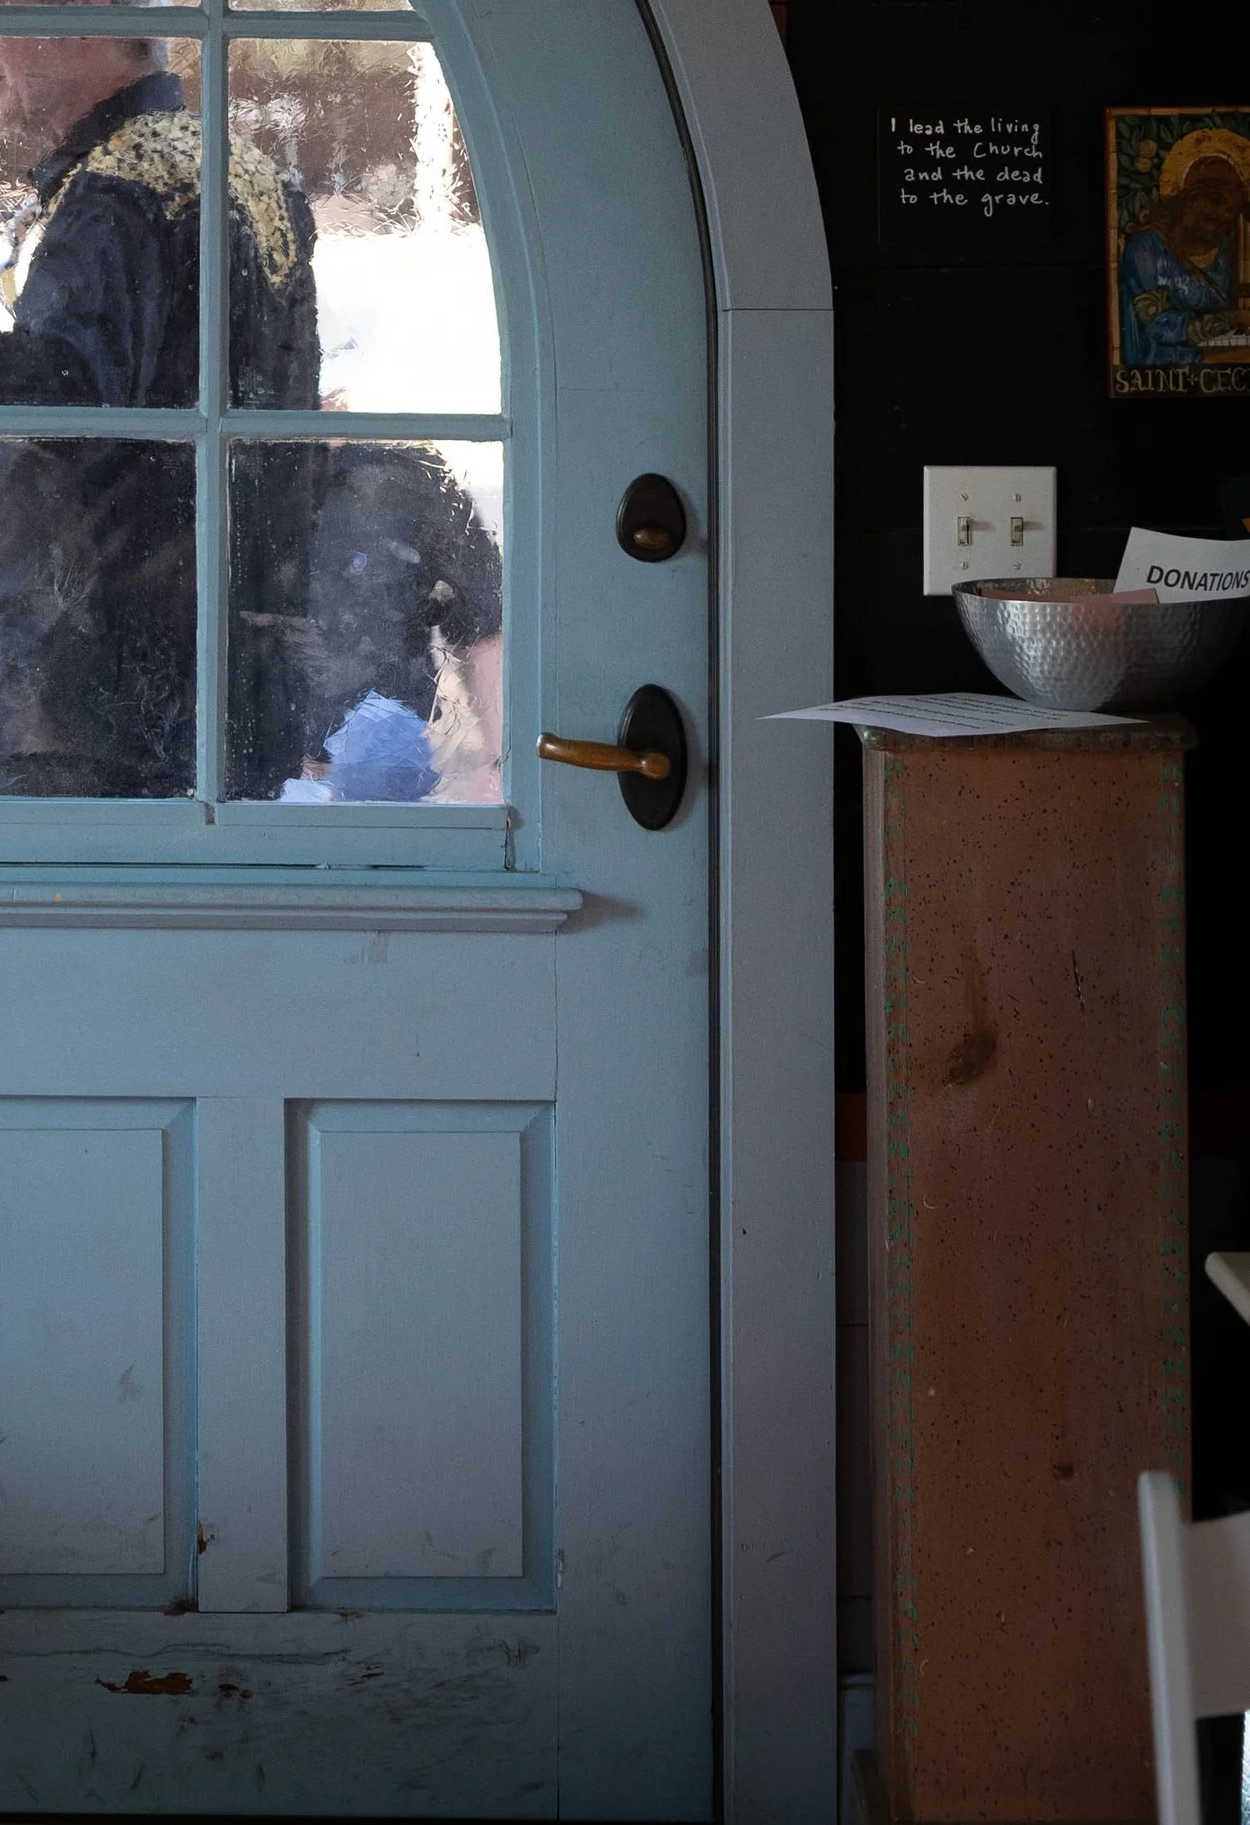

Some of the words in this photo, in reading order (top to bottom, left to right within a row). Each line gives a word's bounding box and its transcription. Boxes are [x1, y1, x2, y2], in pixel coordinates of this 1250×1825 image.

[908, 118, 945, 136] lead
[952, 116, 984, 135] the
[990, 116, 1041, 145] living
[897, 139, 914, 156] to
[924, 140, 957, 159] the
[972, 141, 1044, 159] Church
[903, 166, 943, 182] and
[952, 164, 986, 182] the
[996, 165, 1044, 185] dead
[899, 188, 919, 205] to
[929, 188, 969, 206] the
[980, 192, 1051, 218] grave.
[1115, 366, 1189, 394] SAINT
[1199, 366, 1250, 394] CEC
[1146, 564, 1250, 592] DONATIONS
